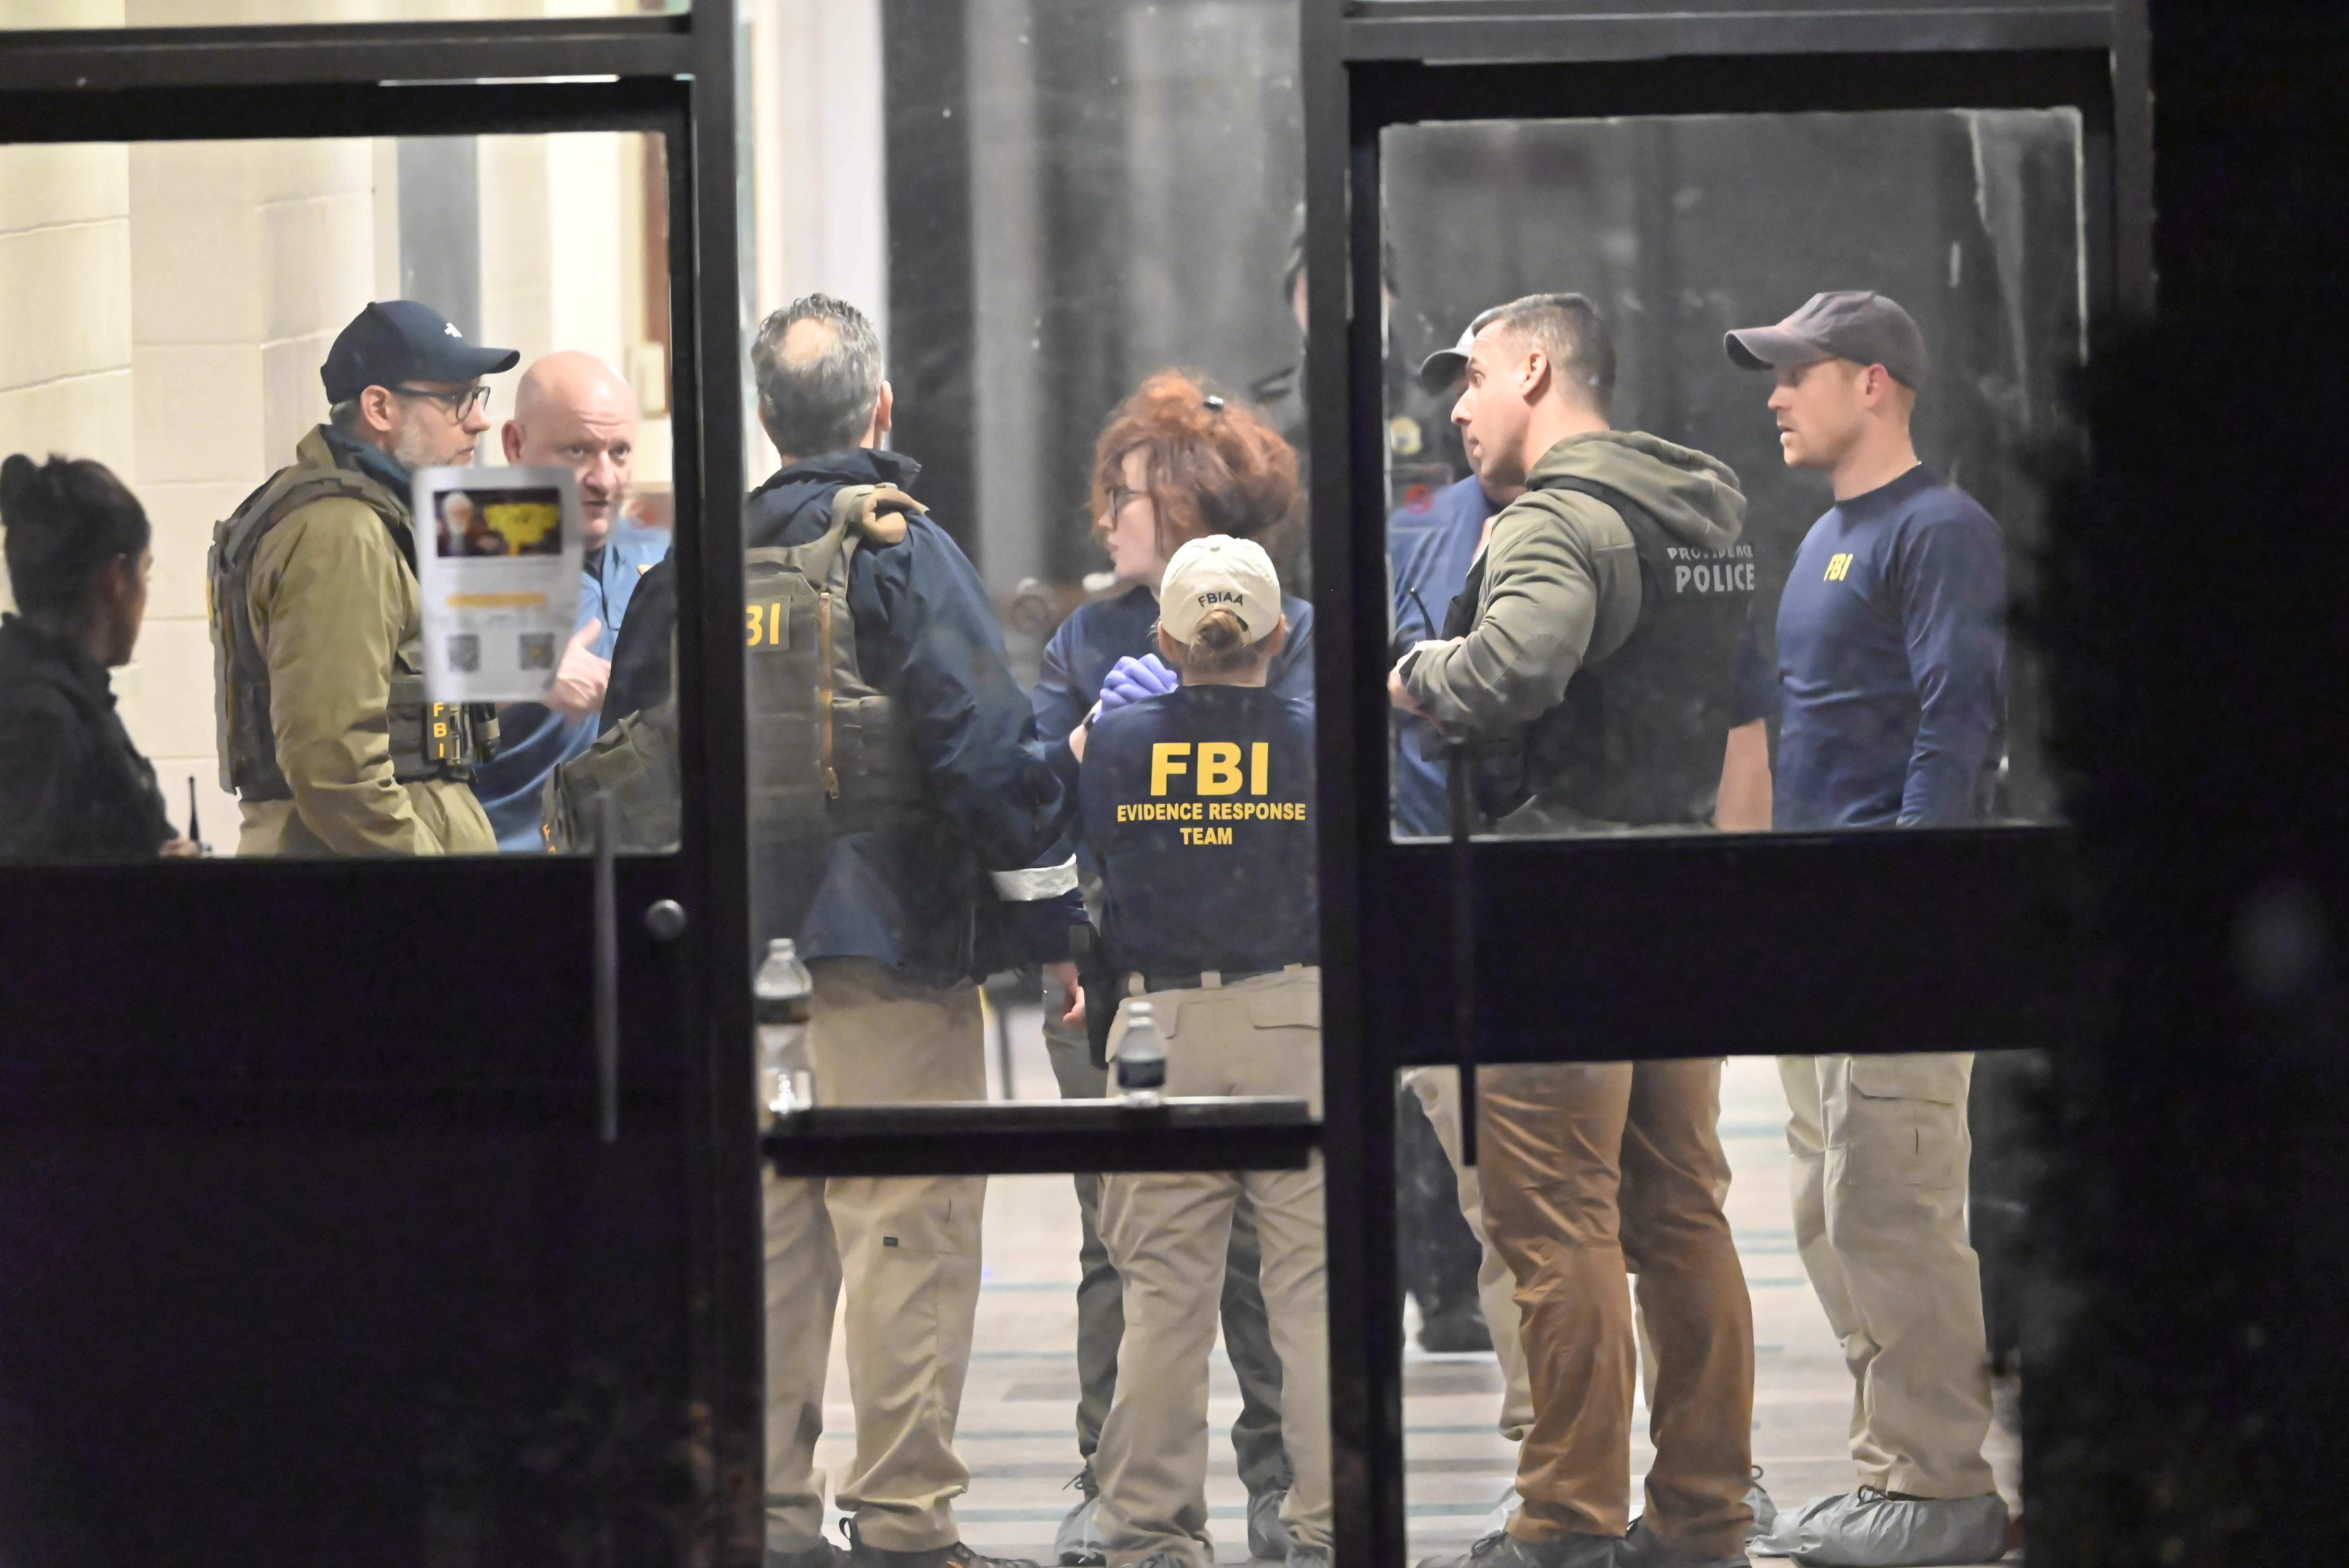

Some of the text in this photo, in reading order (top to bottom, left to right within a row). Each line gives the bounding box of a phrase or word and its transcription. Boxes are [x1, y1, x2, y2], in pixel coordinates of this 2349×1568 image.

[1675, 563, 1755, 593] POLICE
[1823, 553, 1854, 582] FBI
[1198, 592, 1243, 608] FBIAA
[745, 602, 781, 646] BI
[1150, 742, 1269, 796] FBI
[1117, 803, 1306, 822] EVIDENCE RESPONSE
[1180, 827, 1233, 845] TEAM
